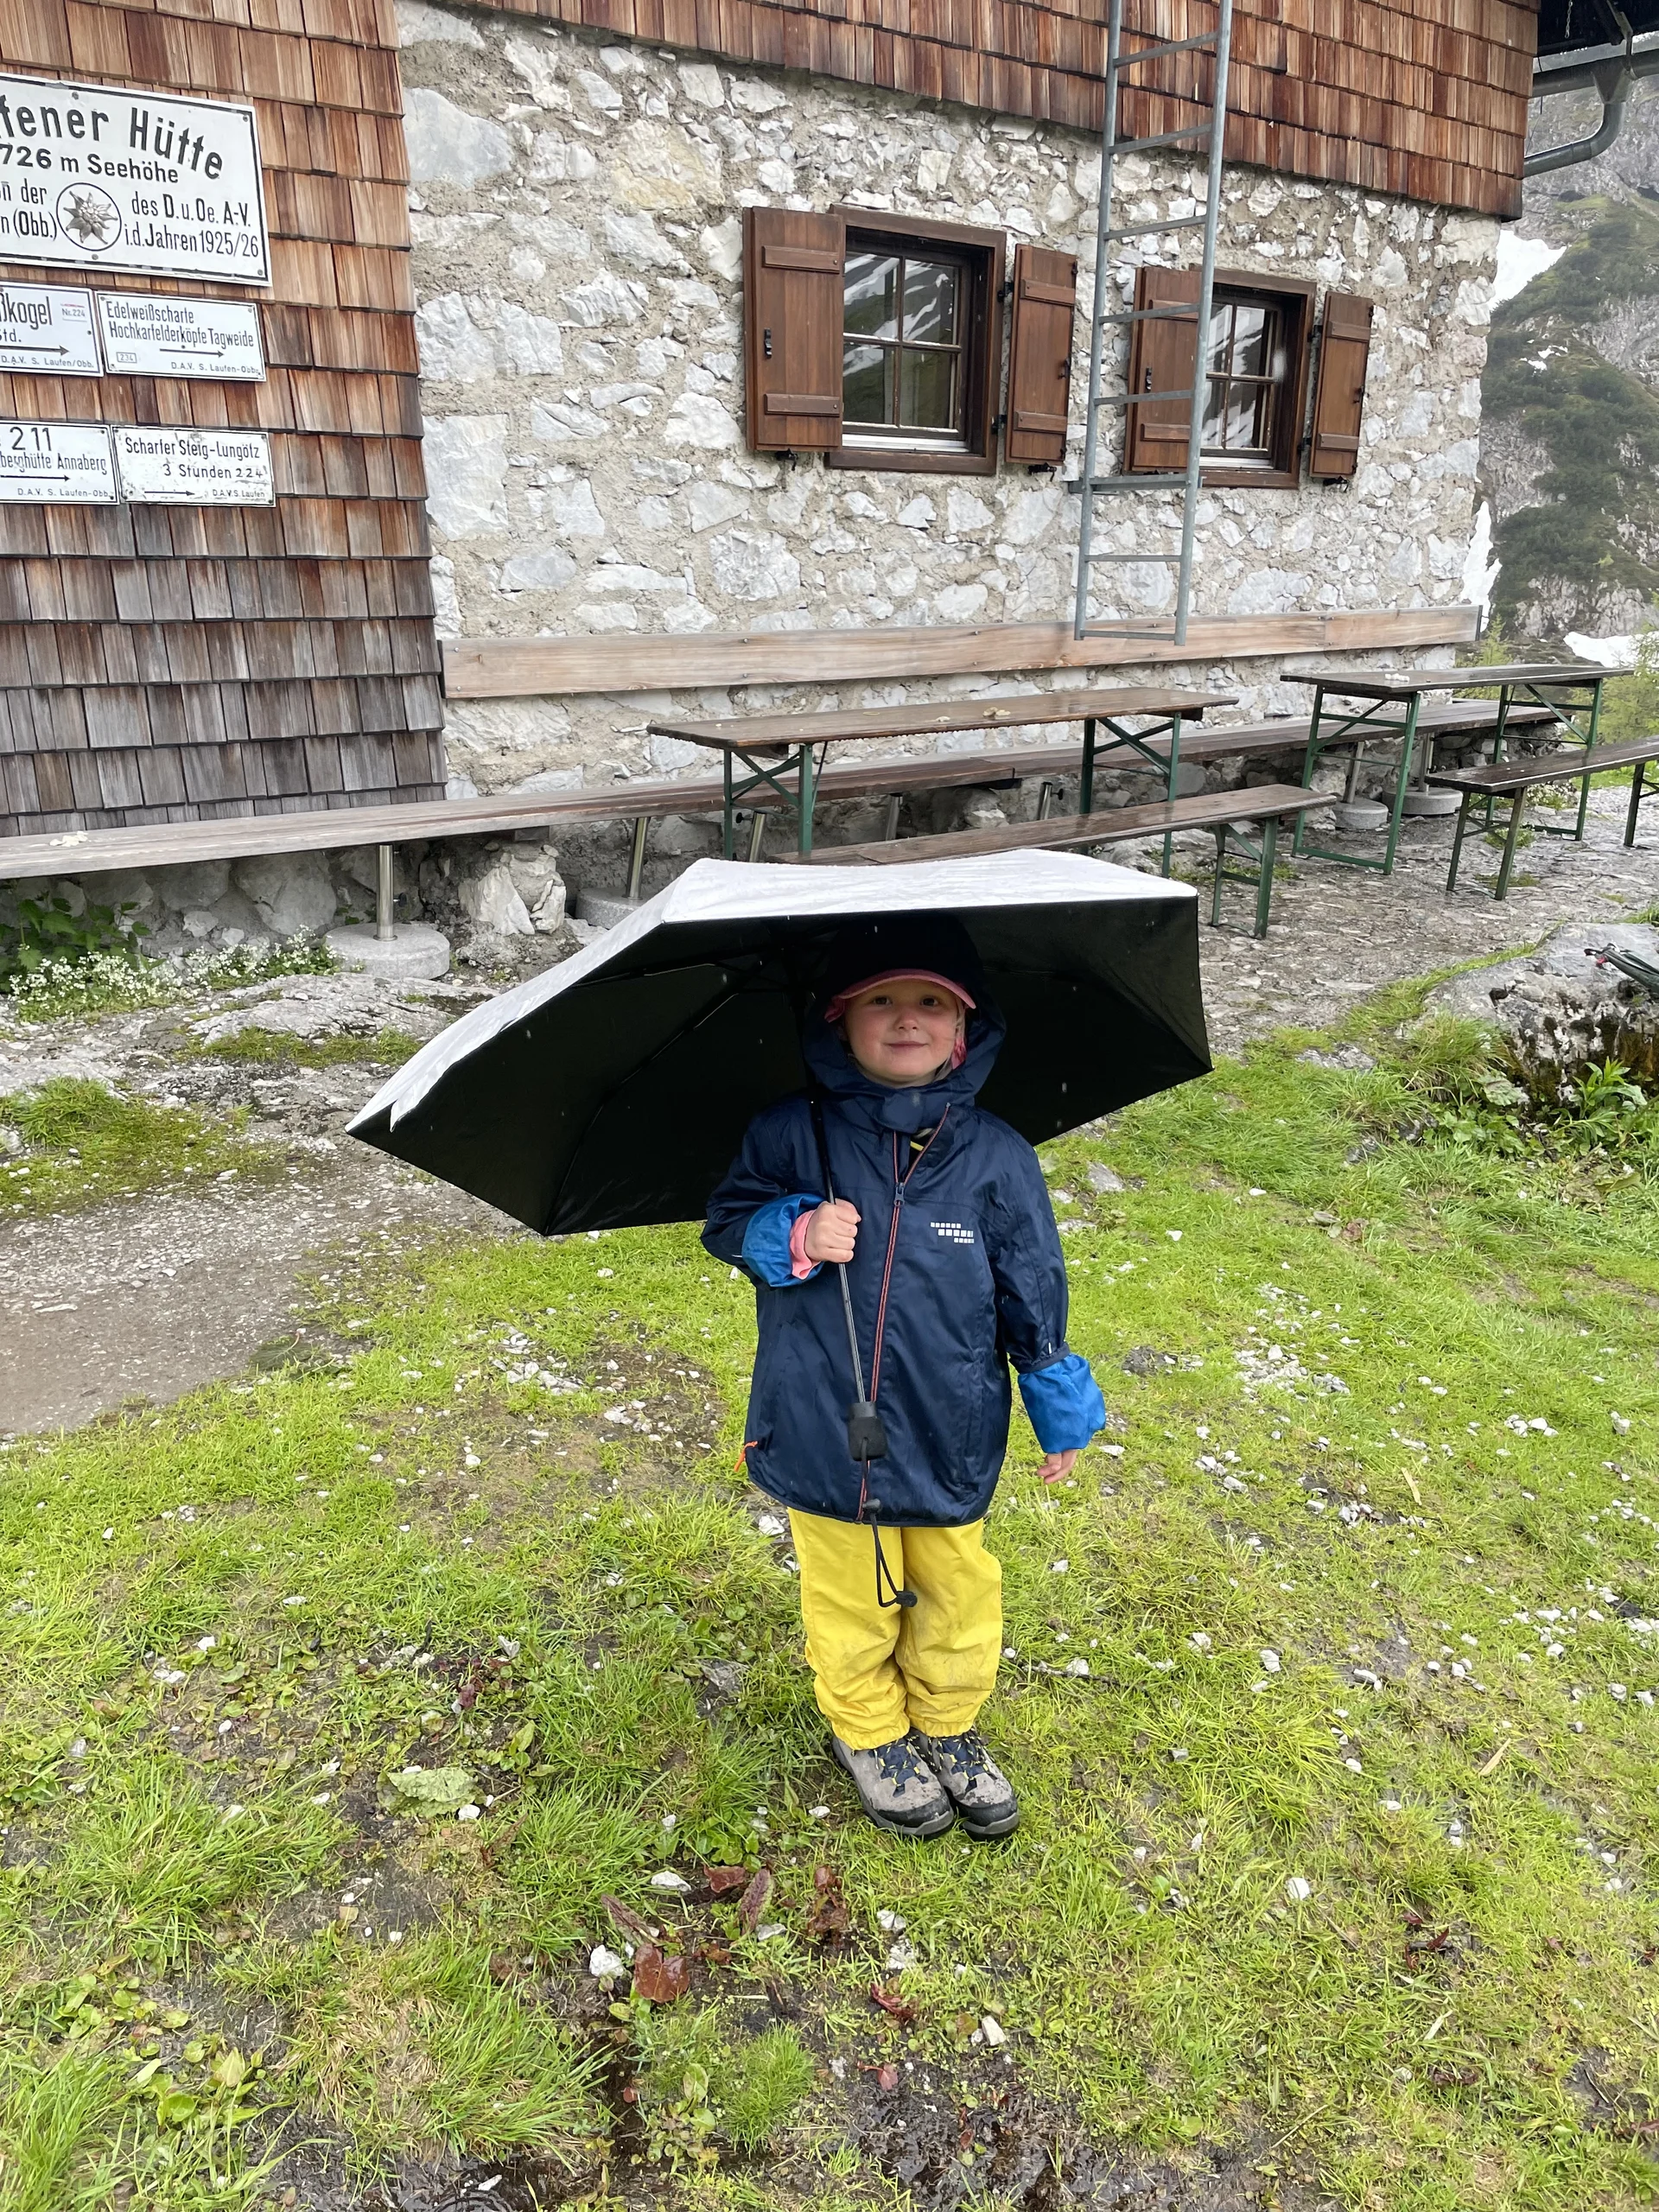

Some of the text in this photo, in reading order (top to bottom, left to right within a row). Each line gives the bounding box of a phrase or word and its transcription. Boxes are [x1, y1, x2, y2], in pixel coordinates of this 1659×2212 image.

[130, 106, 223, 180] Hütte
[0, 143, 179, 184] 726 m Seehöhe
[0, 177, 48, 206] n der
[131, 190, 159, 217] des
[13, 207, 58, 242] (Obb.)
[106, 300, 194, 324] Edelweißscharte
[207, 327, 255, 350] Tagweide
[10, 426, 52, 451] 211
[125, 436, 176, 455] Scharfer
[57, 452, 107, 475] Annaberg
[162, 463, 171, 477] 3
[179, 463, 232, 480] Stunden
